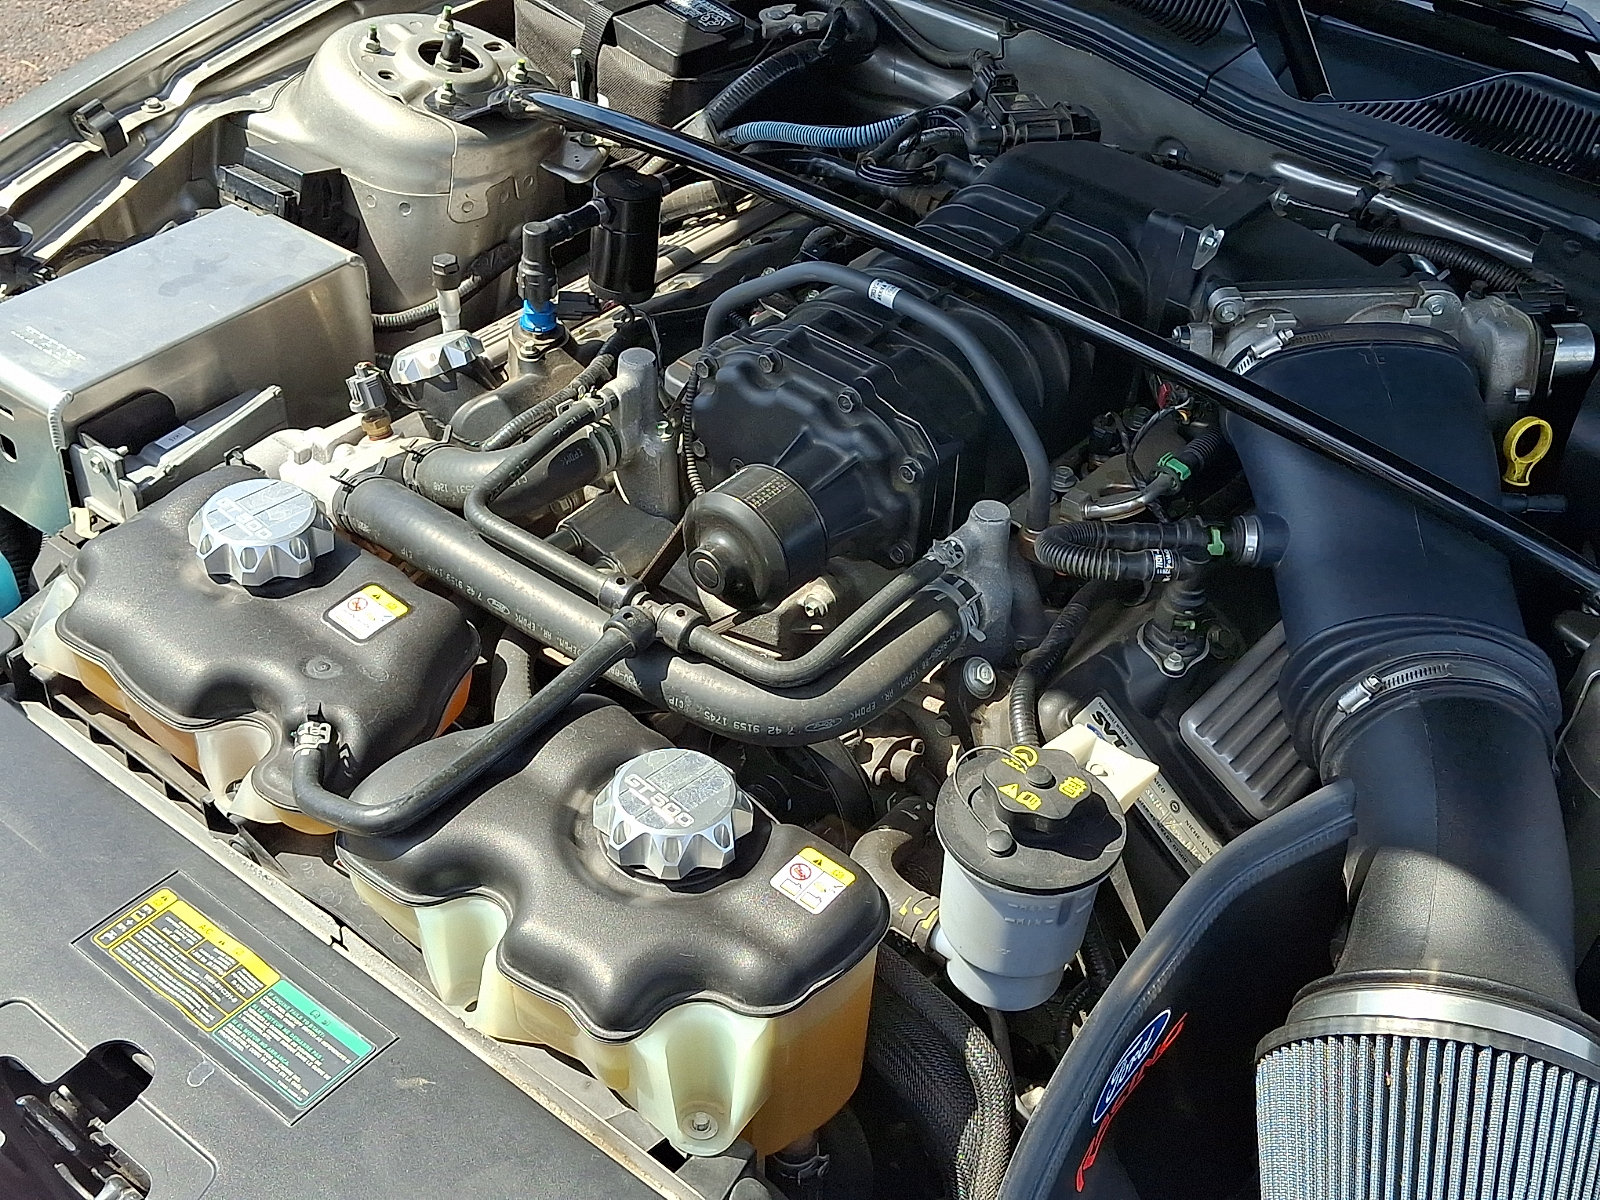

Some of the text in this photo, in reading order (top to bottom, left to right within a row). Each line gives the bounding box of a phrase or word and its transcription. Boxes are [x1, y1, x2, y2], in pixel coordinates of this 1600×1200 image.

[702, 710, 728, 724] 1745
[732, 720, 760, 733] 9159
[766, 725, 782, 737] 42
[1091, 708, 1127, 752] SVT
[624, 773, 695, 828] GT500
[1101, 1020, 1160, 1108] Ford
